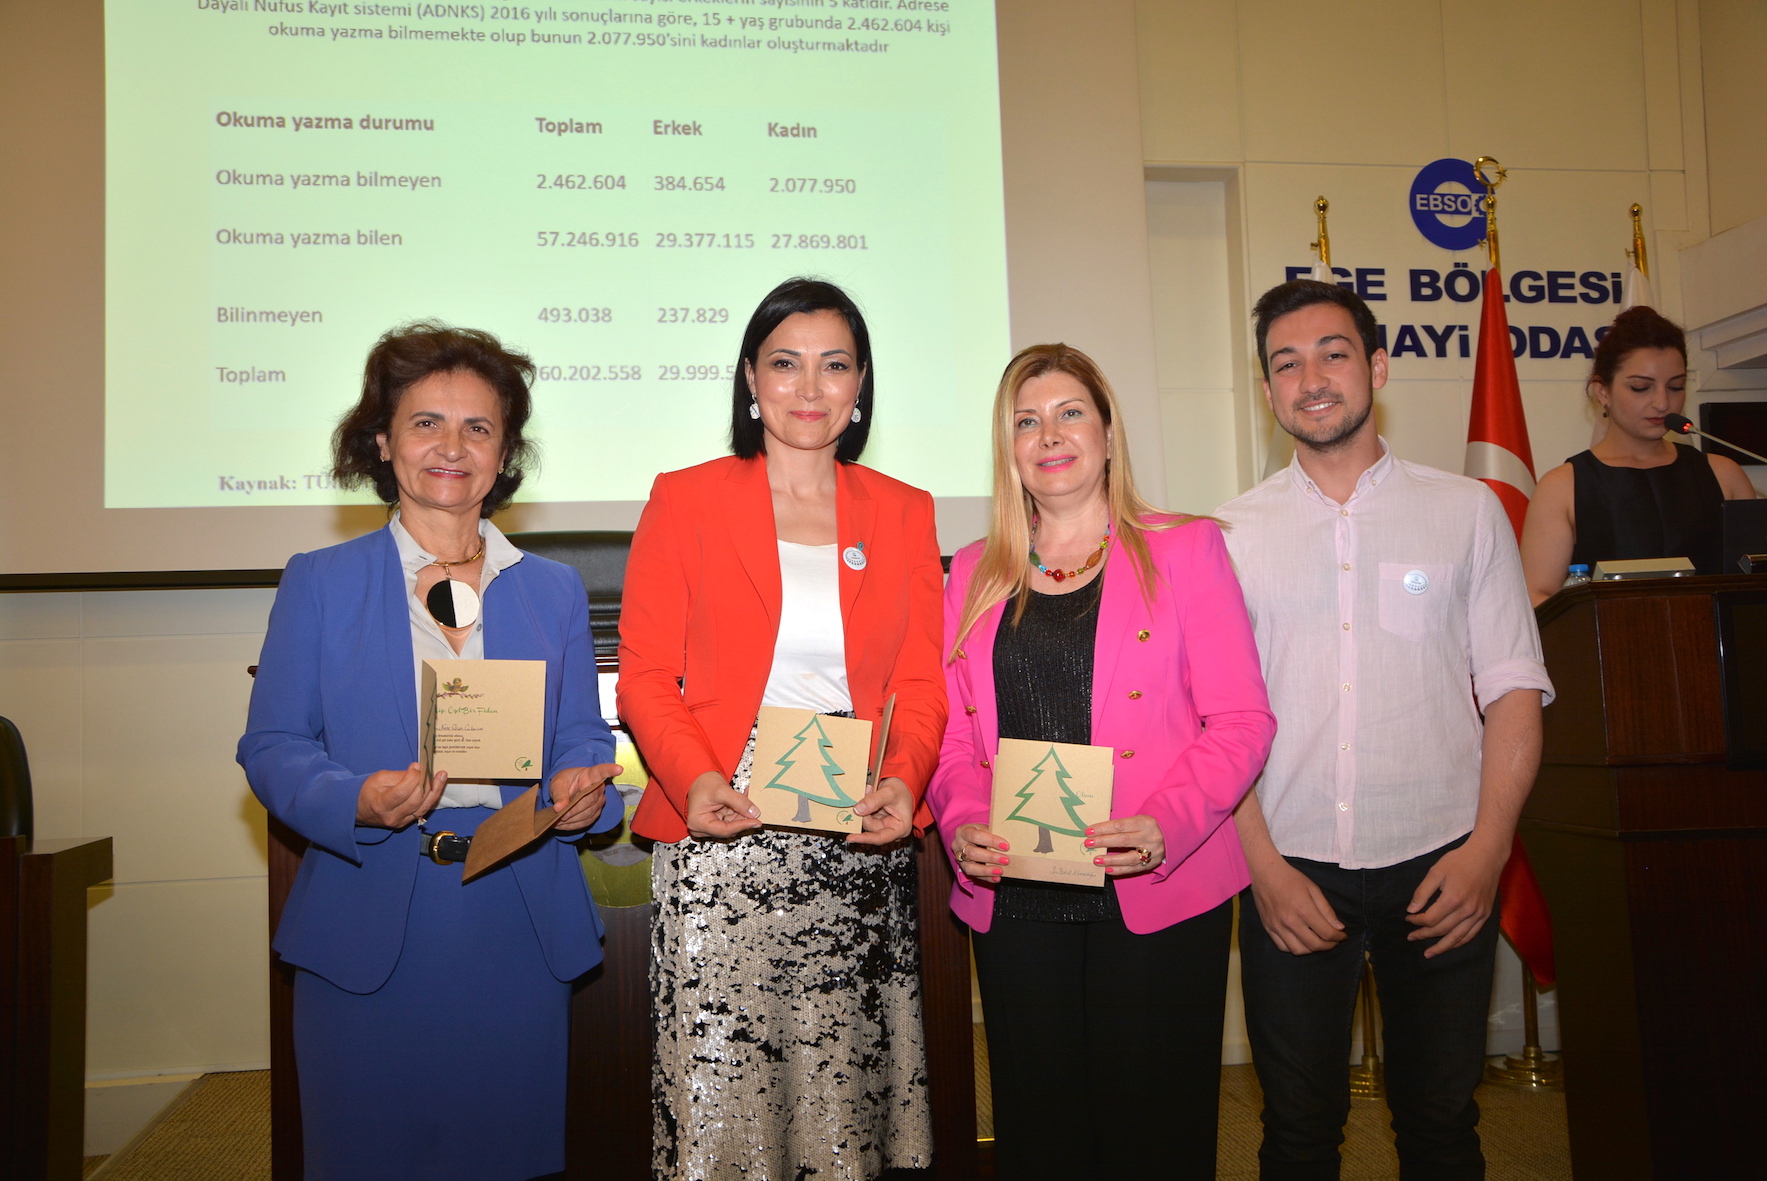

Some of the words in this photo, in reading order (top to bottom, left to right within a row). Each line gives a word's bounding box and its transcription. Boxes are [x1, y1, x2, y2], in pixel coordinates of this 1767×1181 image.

[897, 0, 949, 12] Adrese
[308, 0, 349, 17] Kayıt
[354, 2, 411, 16] sistemi
[417, 3, 485, 22] (ADNKS)
[490, 6, 530, 20] 2016
[534, 7, 557, 23] yılı
[562, 9, 652, 26] sonuçlarına
[657, 11, 697, 28] göre,
[703, 13, 721, 26] 15
[739, 17, 765, 30] yaş
[768, 15, 842, 31] grubunda
[847, 17, 923, 32] 2.462.604
[927, 19, 950, 36] kişi
[269, 22, 325, 37] okuma
[330, 28, 383, 41] yazma
[388, 25, 486, 42] bilmemekte
[490, 28, 526, 46] olup
[531, 29, 582, 44] bunun
[700, 34, 762, 49] kadınlar
[767, 36, 889, 53] oluşturmaktadır
[216, 111, 286, 128] Okuma
[291, 116, 353, 132] yazma
[359, 114, 434, 131] durumu
[534, 117, 602, 136] Toplam
[653, 119, 703, 136] Erkek
[768, 122, 817, 138] Kadın
[216, 169, 284, 185] Okuma
[290, 174, 350, 189] yazma
[357, 171, 441, 191] bilmeyen
[537, 174, 627, 190] 2.462.604
[654, 176, 726, 191] 384.654
[770, 178, 856, 193] 2.077.950
[1416, 194, 1472, 212] EBSO
[216, 228, 284, 245] Okuma
[290, 233, 351, 248] yazma
[357, 229, 402, 245] bilen
[537, 231, 639, 247] 57.246.916
[656, 233, 754, 248] 29.377.115
[771, 234, 868, 250] 27.869.801
[217, 307, 322, 326] Bilinmeyen
[538, 307, 612, 323] 493.038
[657, 308, 729, 323] 237.829
[216, 366, 286, 385] Toplam
[537, 365, 642, 381] 60.202.558
[658, 365, 735, 381] 29.999.5
[218, 475, 296, 495] Kaynak:
